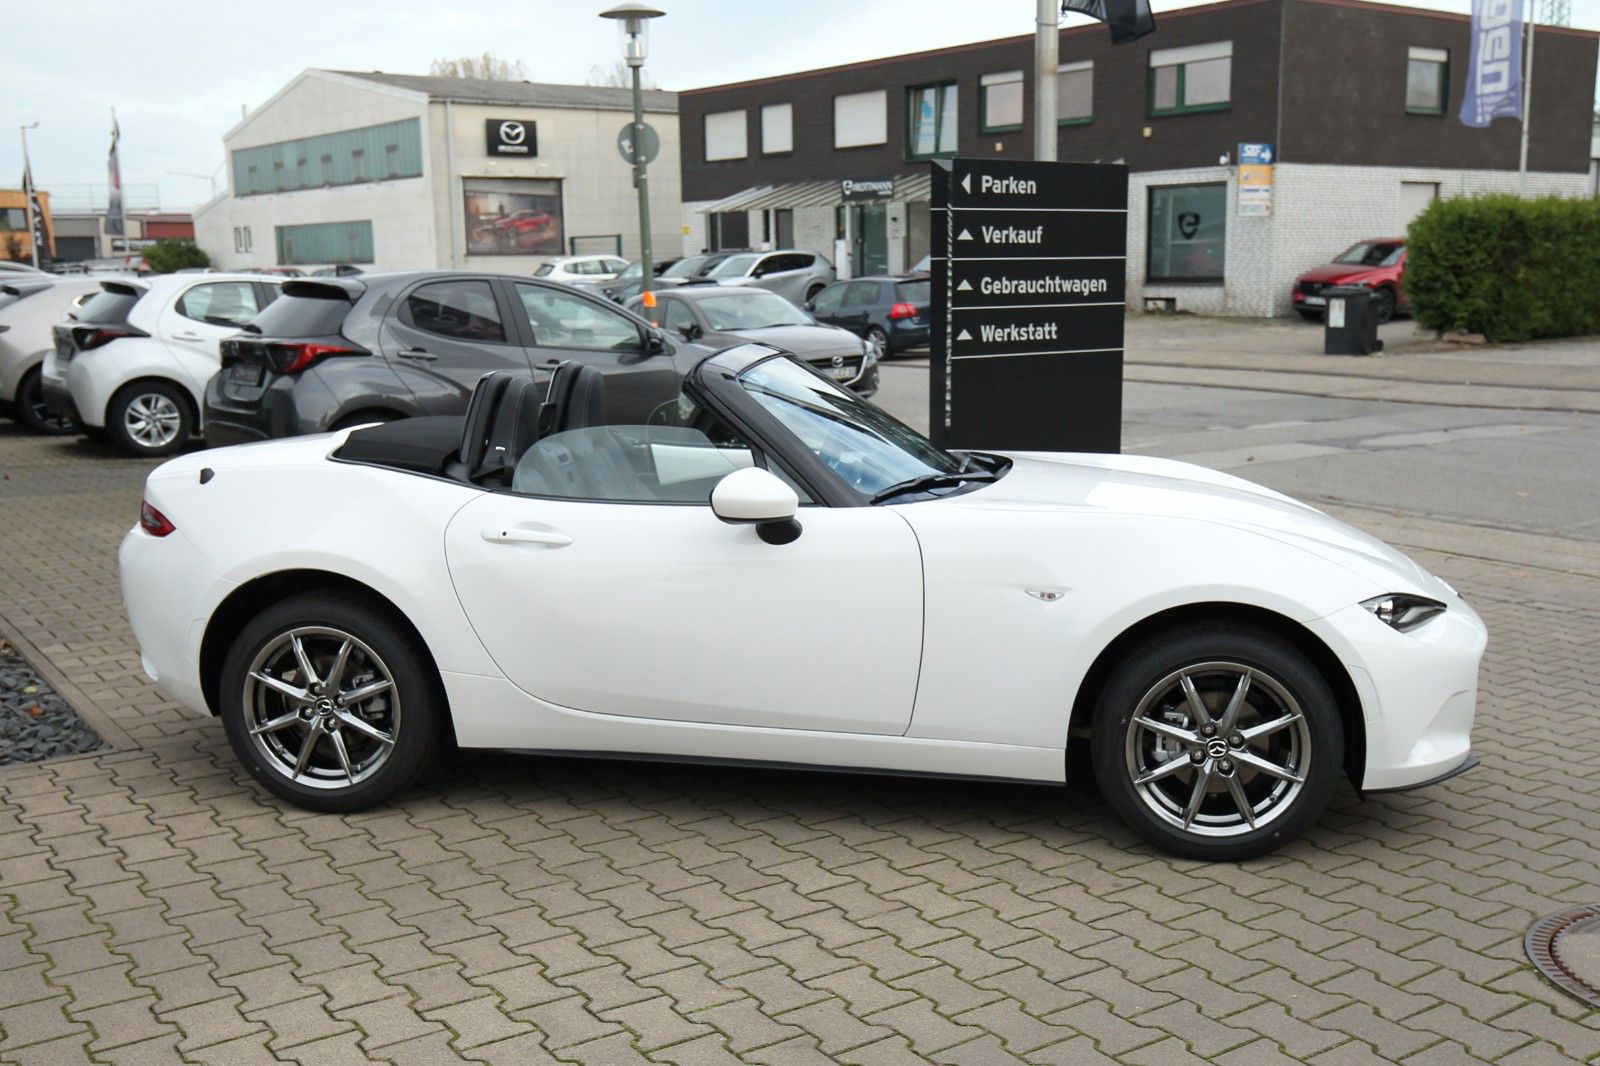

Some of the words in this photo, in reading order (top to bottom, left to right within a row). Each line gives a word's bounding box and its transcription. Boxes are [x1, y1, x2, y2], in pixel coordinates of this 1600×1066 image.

[981, 174, 1037, 194] Parken
[981, 225, 1043, 244] Verkauf
[980, 275, 1107, 296] Gebrauchtwagen
[980, 322, 1057, 343] Werkstatt
